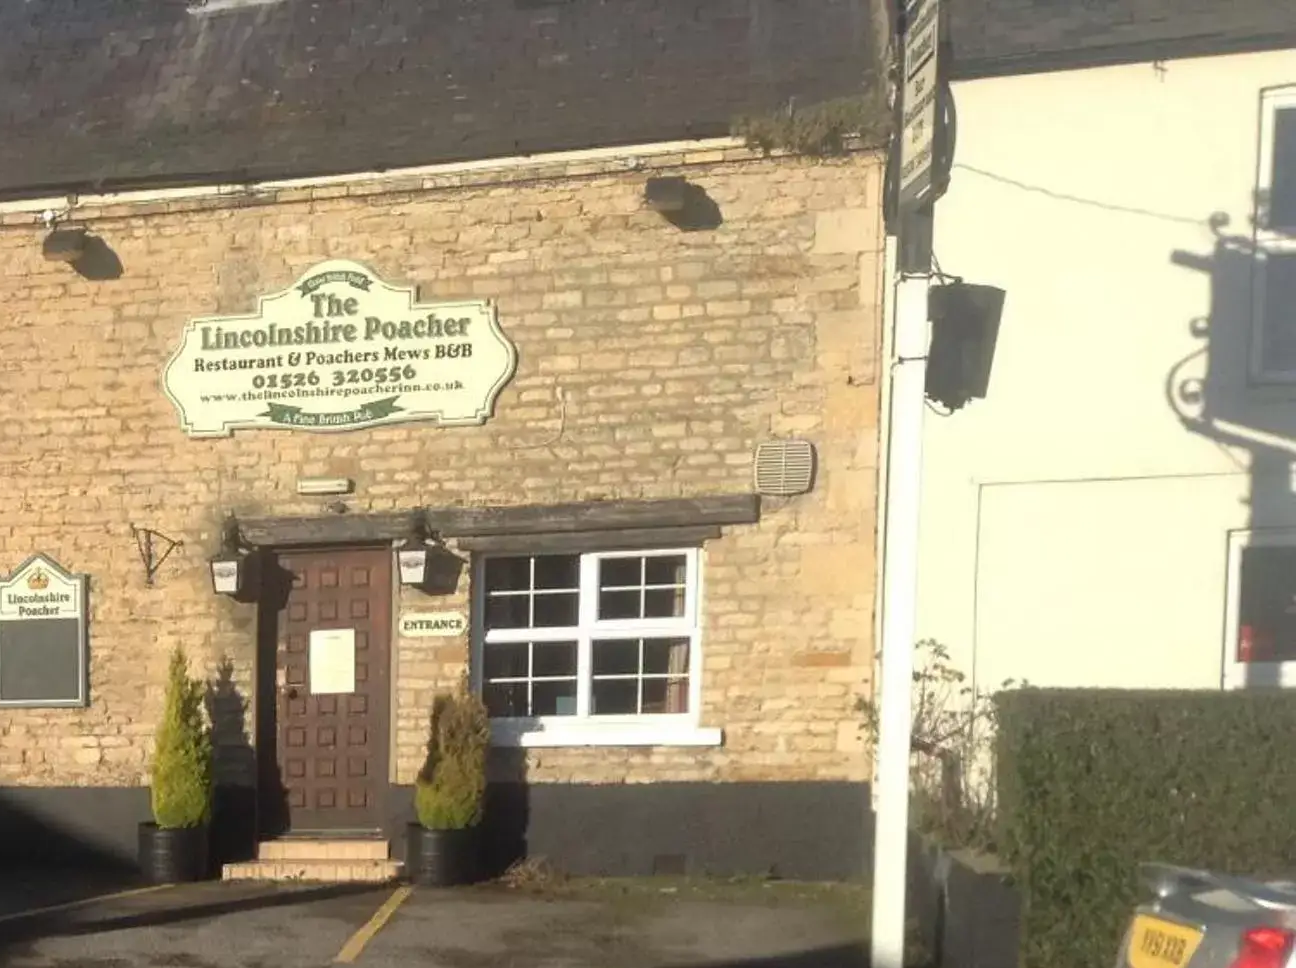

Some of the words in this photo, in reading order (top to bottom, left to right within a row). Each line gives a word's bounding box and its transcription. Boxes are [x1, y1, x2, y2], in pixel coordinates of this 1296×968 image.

[310, 294, 359, 318] The
[200, 320, 358, 350] Lincolnshire
[364, 313, 472, 341] Poacher
[194, 355, 283, 373] Restaurant
[287, 352, 301, 367] &
[304, 348, 379, 366] Poachers
[384, 346, 430, 361] Mews
[435, 344, 473, 359] B&B
[252, 371, 321, 389] 01526
[332, 365, 416, 386] 320556
[200, 380, 464, 403] www.thelincolnshirepoacherinn.co.uk
[7, 592, 70, 605] Lincolnshire
[403, 619, 462, 630] ENTRANCE
